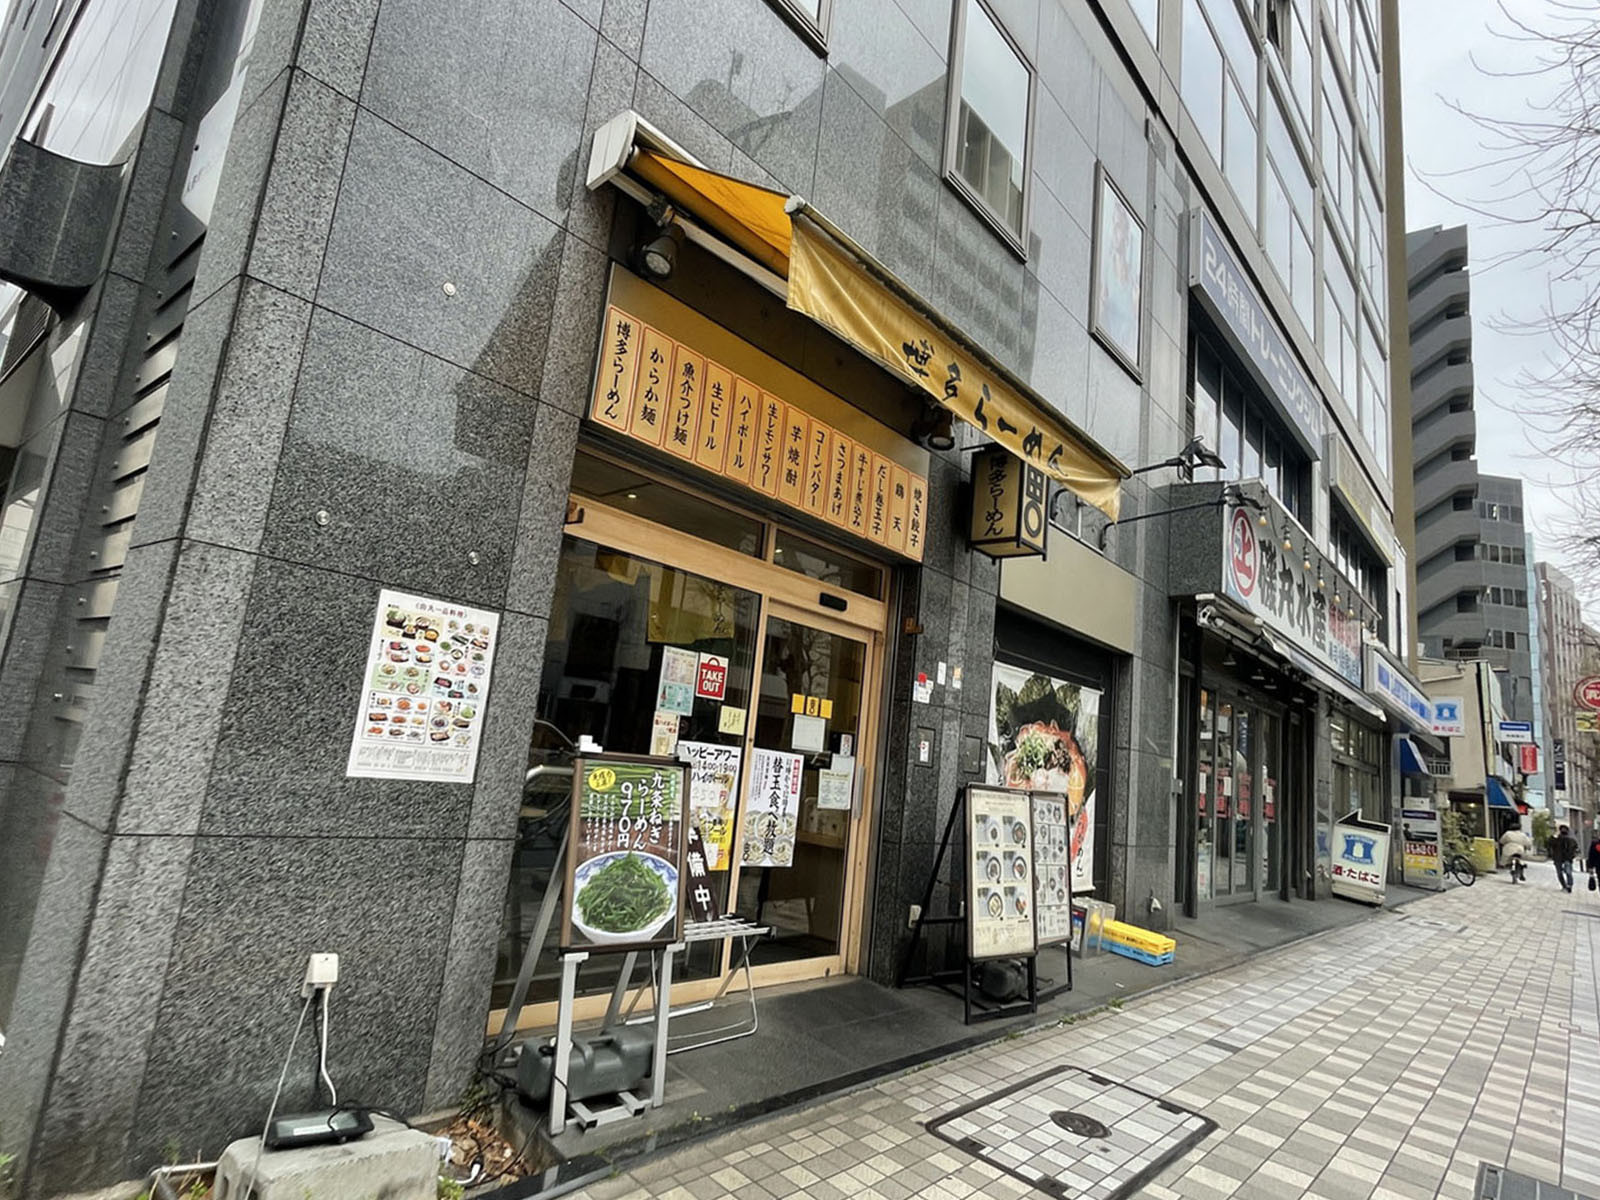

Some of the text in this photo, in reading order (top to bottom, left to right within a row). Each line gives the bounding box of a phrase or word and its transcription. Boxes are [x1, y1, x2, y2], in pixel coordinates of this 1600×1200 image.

[605, 320, 631, 420] 博多らーめん
[641, 348, 664, 425] からか麺
[673, 362, 695, 445] 魚介つけ麺
[705, 381, 724, 450] 生ビール
[733, 395, 752, 469] ハイボール
[761, 403, 779, 487] 生レモンサワー
[786, 425, 802, 487] 芋焼酎
[811, 430, 825, 507] コーンバター
[832, 443, 846, 515] さつまあげ
[701, 669, 723, 683] TAKE
[702, 681, 720, 693] OUT
[617, 782, 633, 848] 970円
[633, 778, 649, 850] らーめん
[649, 772, 665, 844] 九条ねぎ
[763, 756, 783, 855] 替玉食べ放題
[1332, 864, 1380, 885] 酒・たばこ
